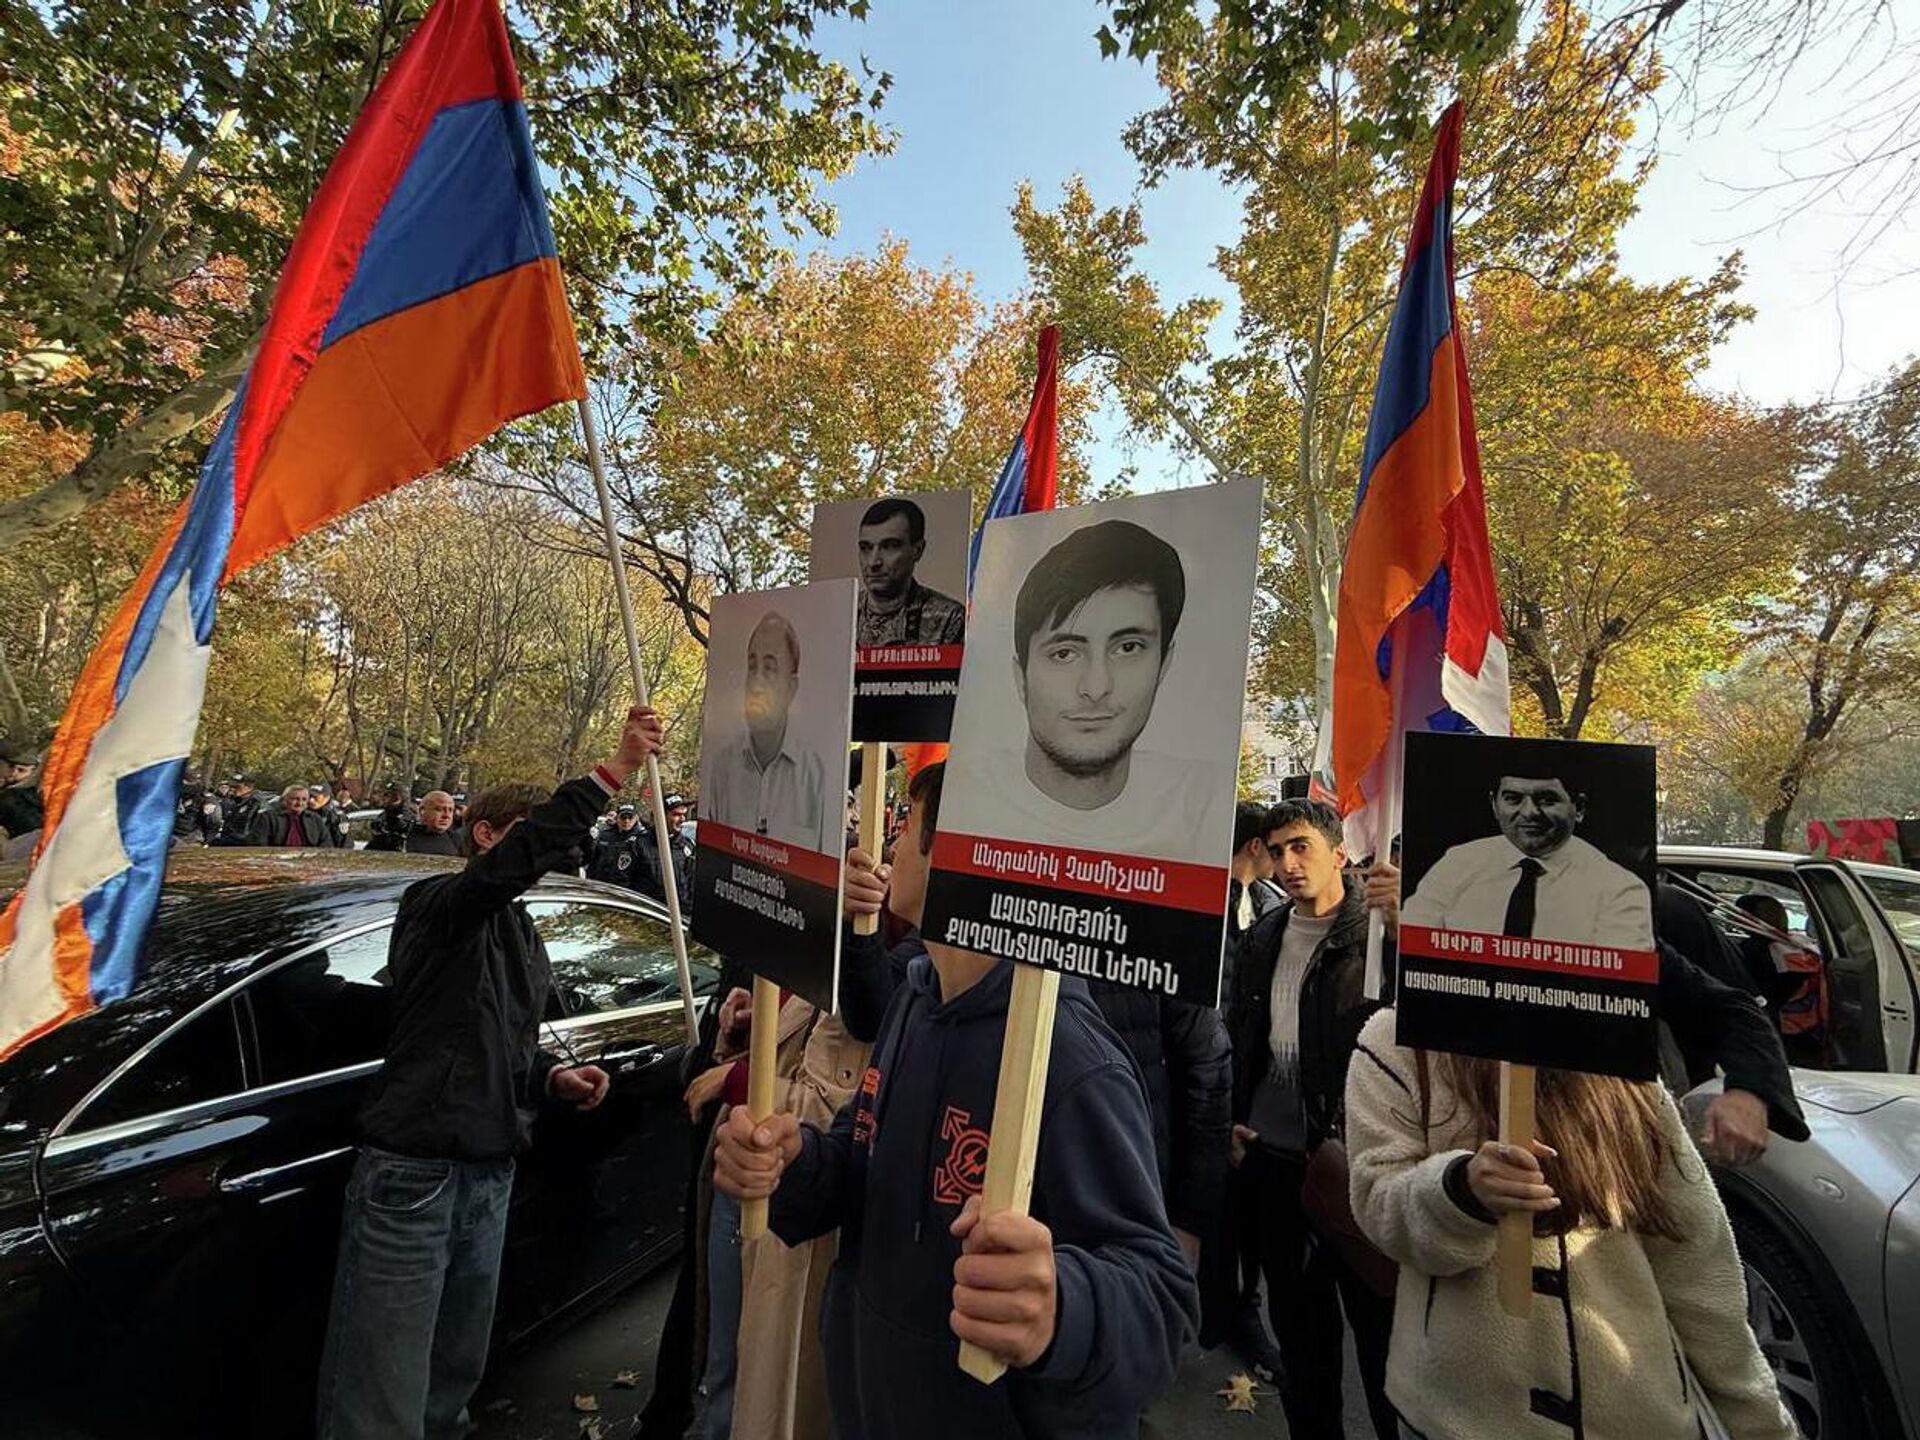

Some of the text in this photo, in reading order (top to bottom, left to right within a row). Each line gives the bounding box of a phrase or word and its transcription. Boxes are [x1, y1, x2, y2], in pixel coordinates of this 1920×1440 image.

[972, 842, 1165, 893] Անդրանիկ Չամիչյան
[944, 917, 1179, 995] ՔԱՂԲԱՆՏԱՐԿՅԱԼՆԵՐԻՆ
[1430, 932, 1623, 970] ԴԱՎԻԹ ՀԱՄԲԱՐՁՈՒՄՅԱՆ
[1494, 981, 1650, 1018] ՔԱՂԲԱՆՏԱՐԿՅԱԼՆԵՐԻՆ
